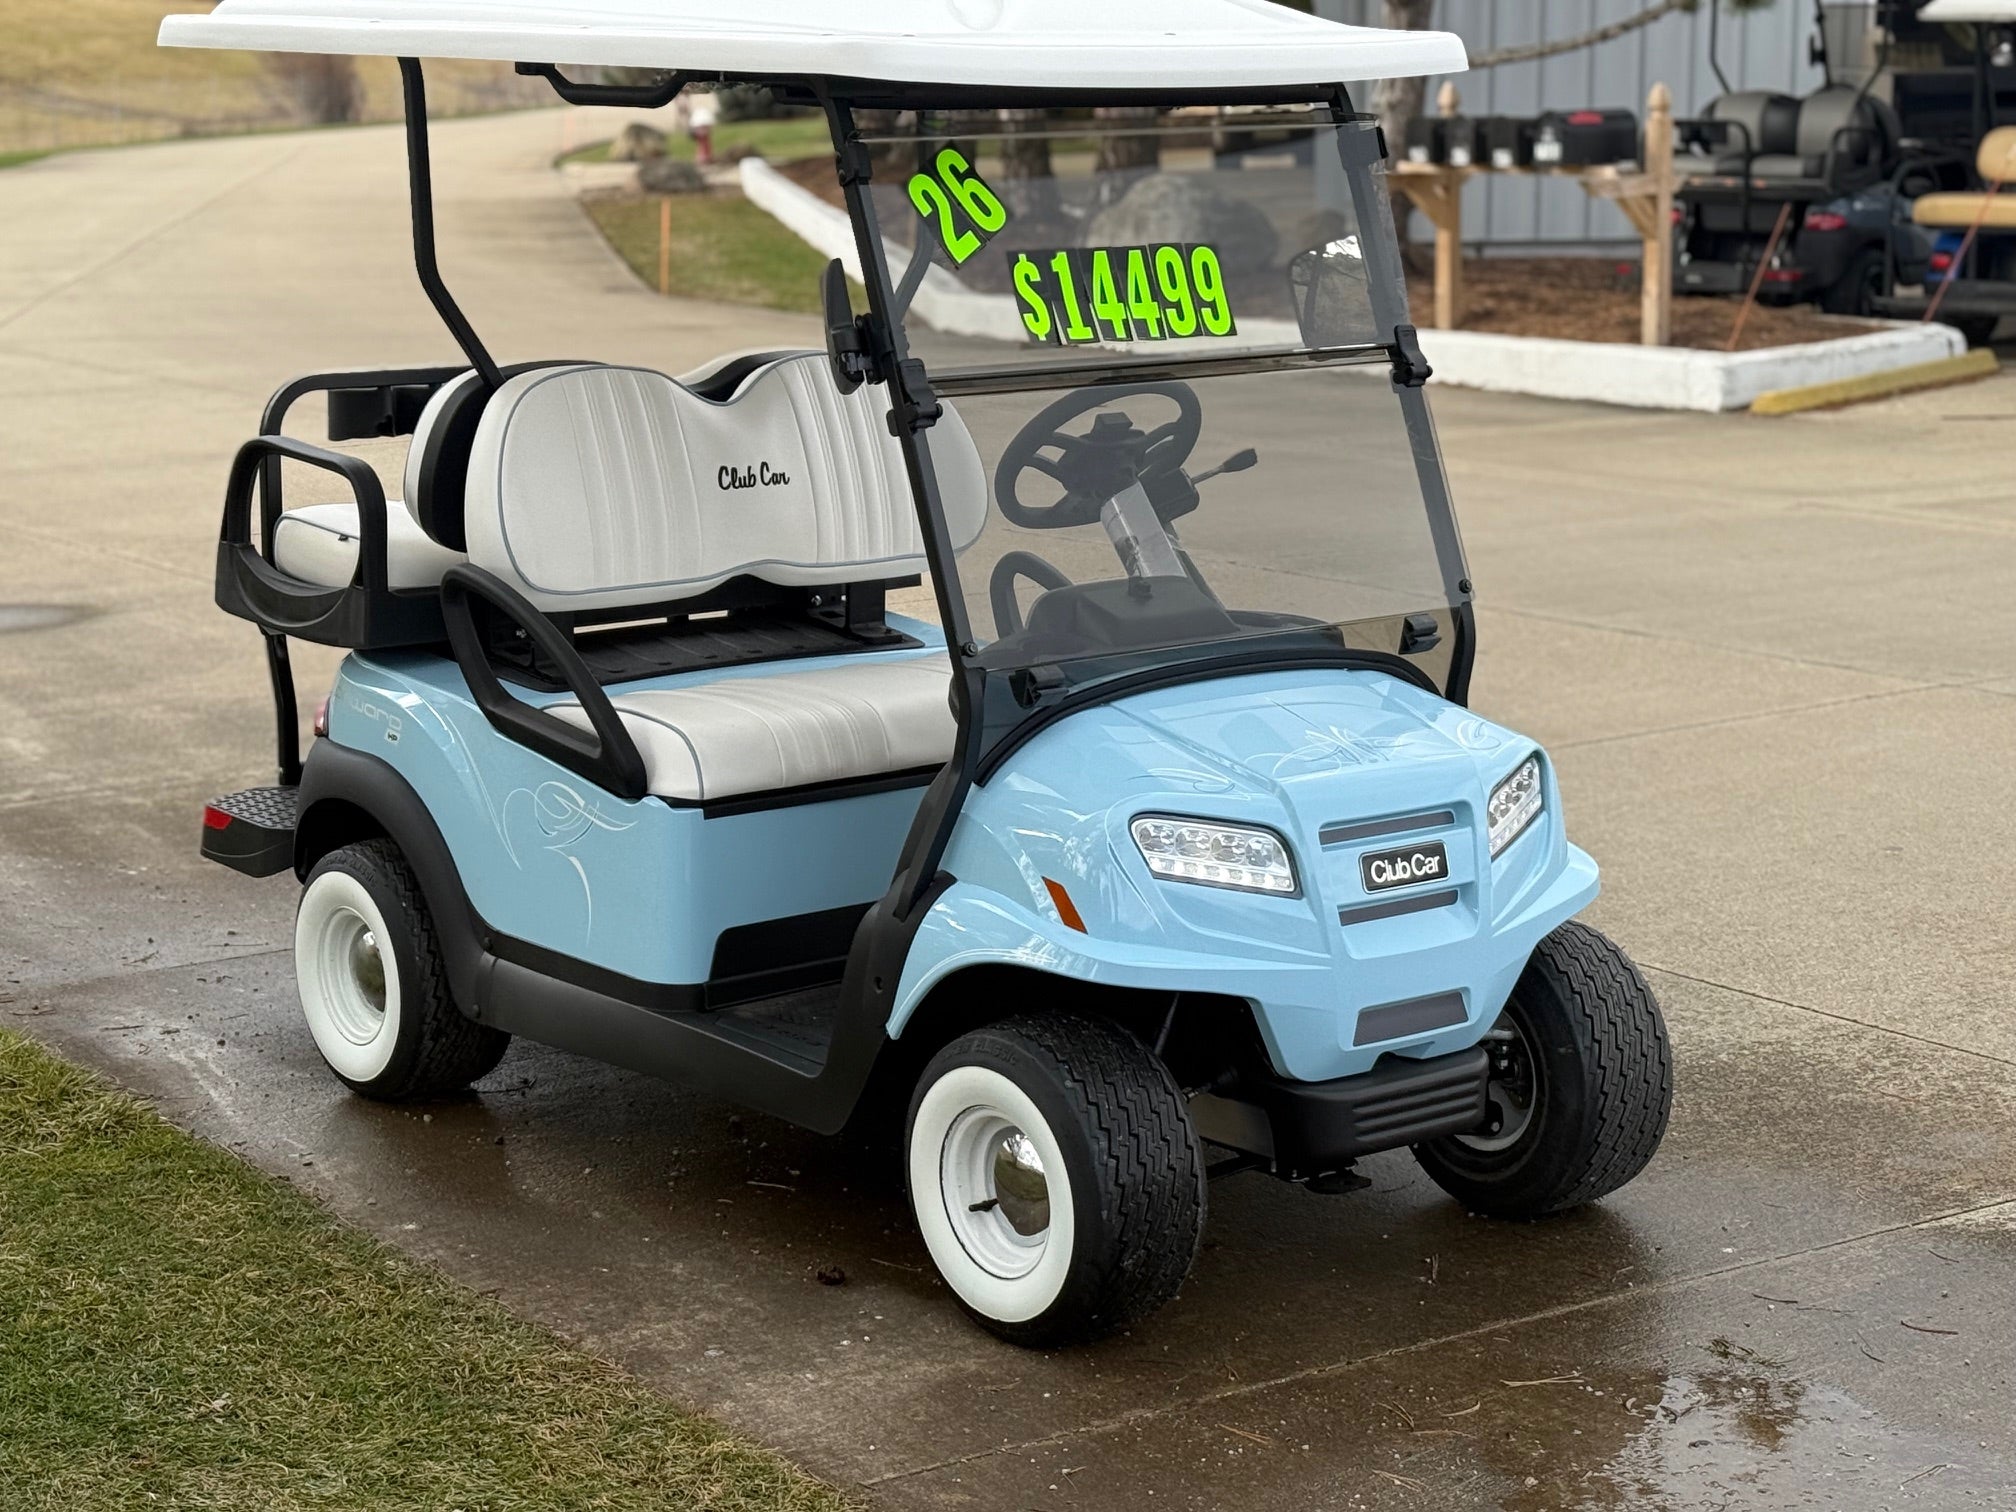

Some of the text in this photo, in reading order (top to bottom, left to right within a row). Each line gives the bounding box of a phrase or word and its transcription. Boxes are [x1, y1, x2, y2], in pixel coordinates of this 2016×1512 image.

[908, 148, 1007, 264] 26
[1013, 246, 1233, 341] $14499
[718, 461, 790, 490] Club Car
[1370, 853, 1440, 883] Club Car
